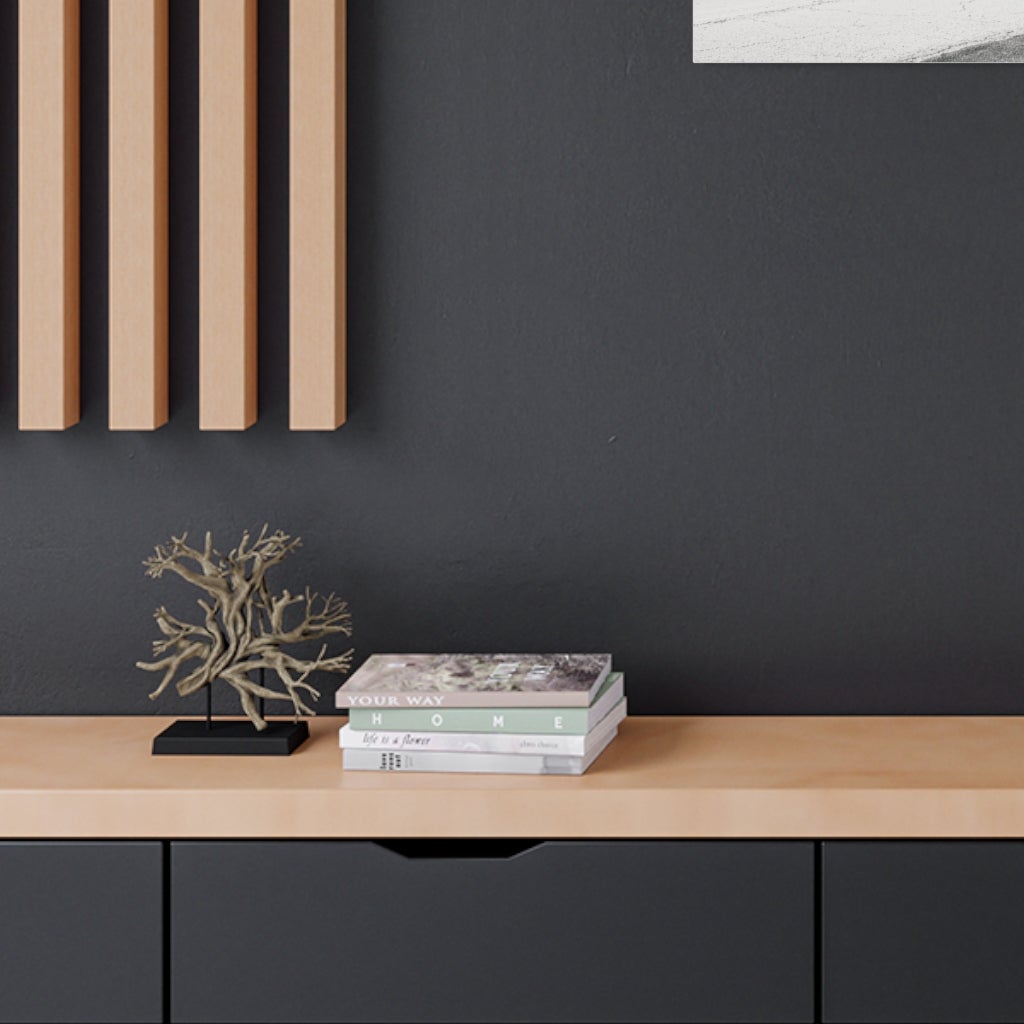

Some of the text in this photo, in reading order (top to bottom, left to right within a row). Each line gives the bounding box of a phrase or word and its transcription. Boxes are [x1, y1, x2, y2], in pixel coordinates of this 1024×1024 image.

[347, 695, 445, 706] YOUR WAY
[371, 713, 563, 729] HOME
[362, 732, 379, 746] life
[399, 733, 431, 748] flower
